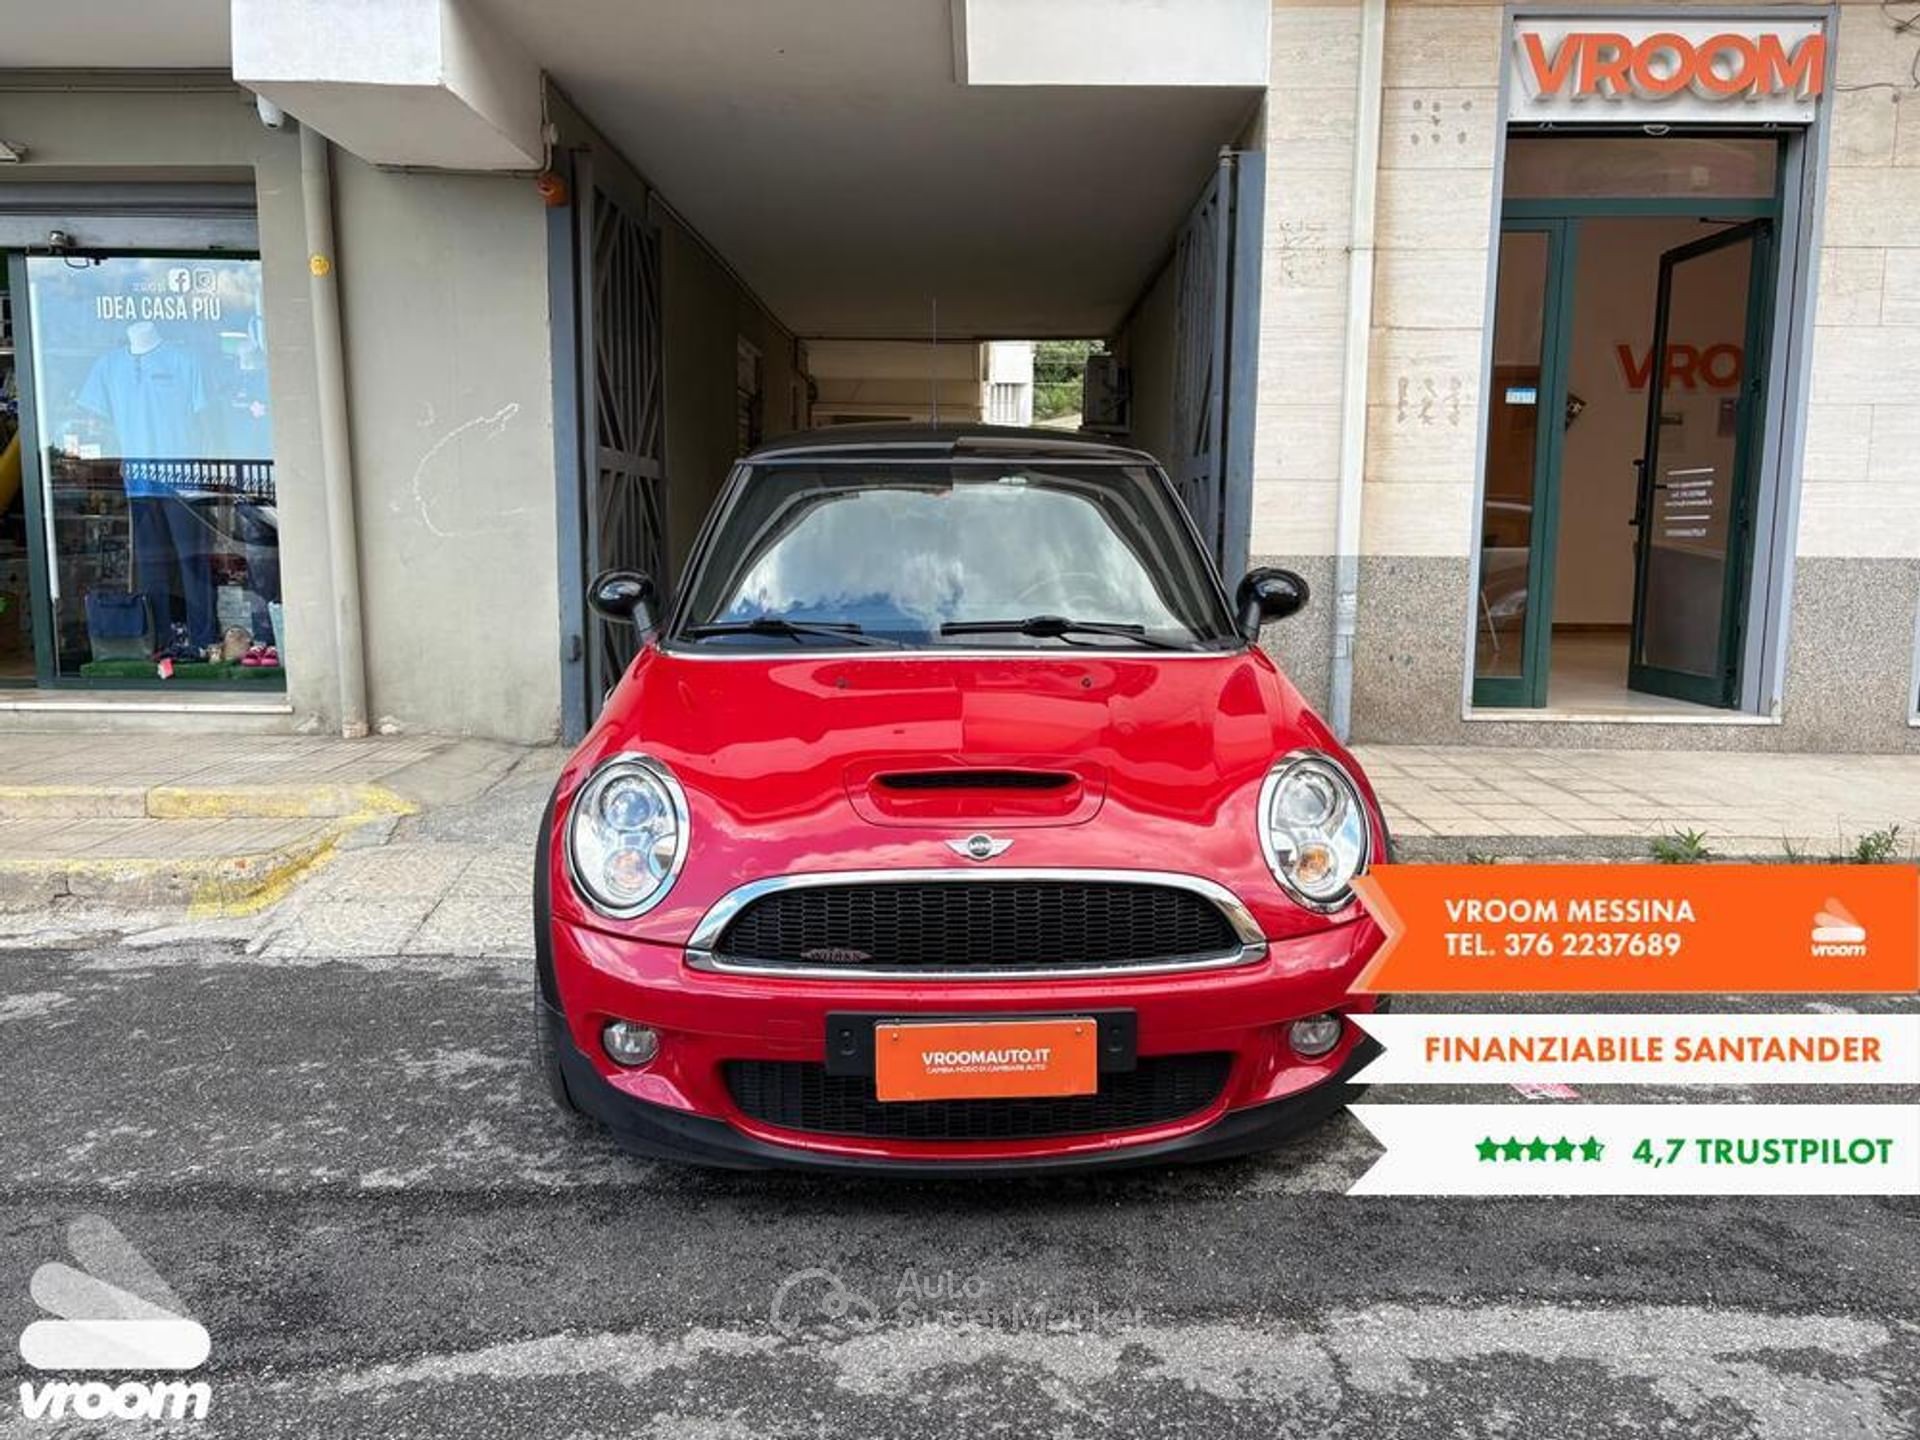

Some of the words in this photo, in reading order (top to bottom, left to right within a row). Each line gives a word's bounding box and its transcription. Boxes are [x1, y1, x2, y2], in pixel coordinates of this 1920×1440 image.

[1521, 32, 1828, 96] VROOM
[96, 295, 137, 320] IDEA
[141, 296, 188, 321] CASA
[922, 1048, 1051, 1065] VROOMAUTO.IT
